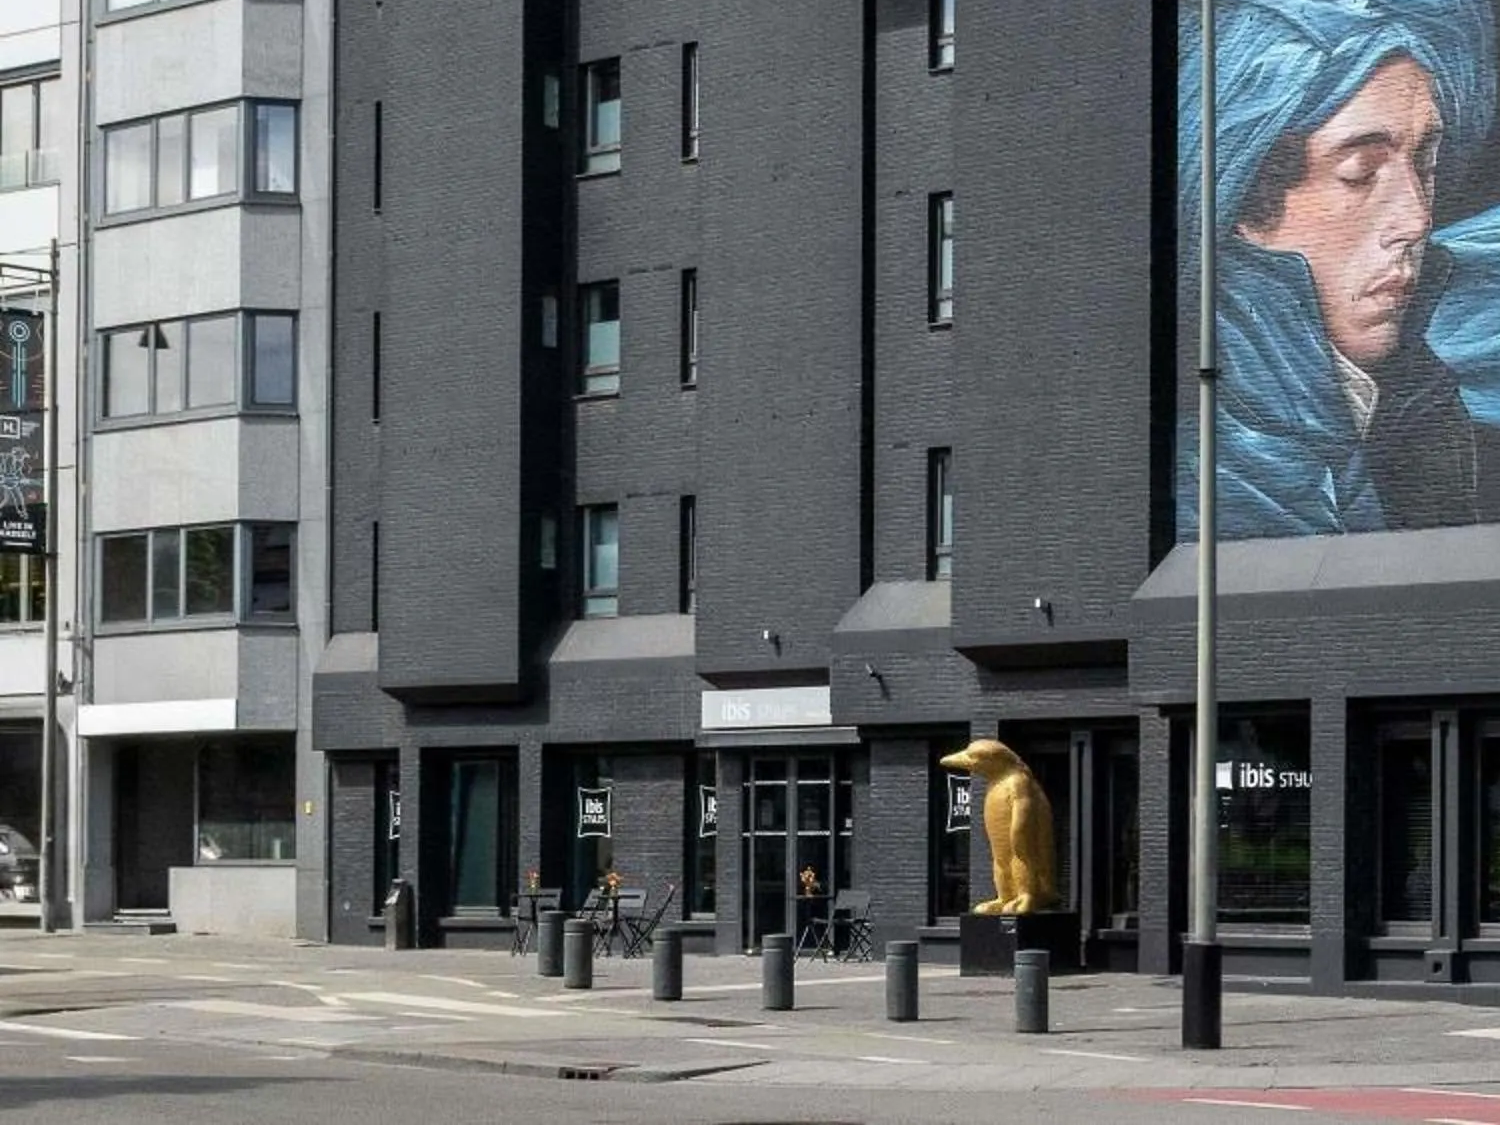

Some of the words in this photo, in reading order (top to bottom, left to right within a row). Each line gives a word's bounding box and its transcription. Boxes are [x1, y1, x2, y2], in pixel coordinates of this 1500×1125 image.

[1239, 762, 1275, 788] ibis
[1279, 771, 1313, 788] STYL
[585, 798, 604, 814] ibis
